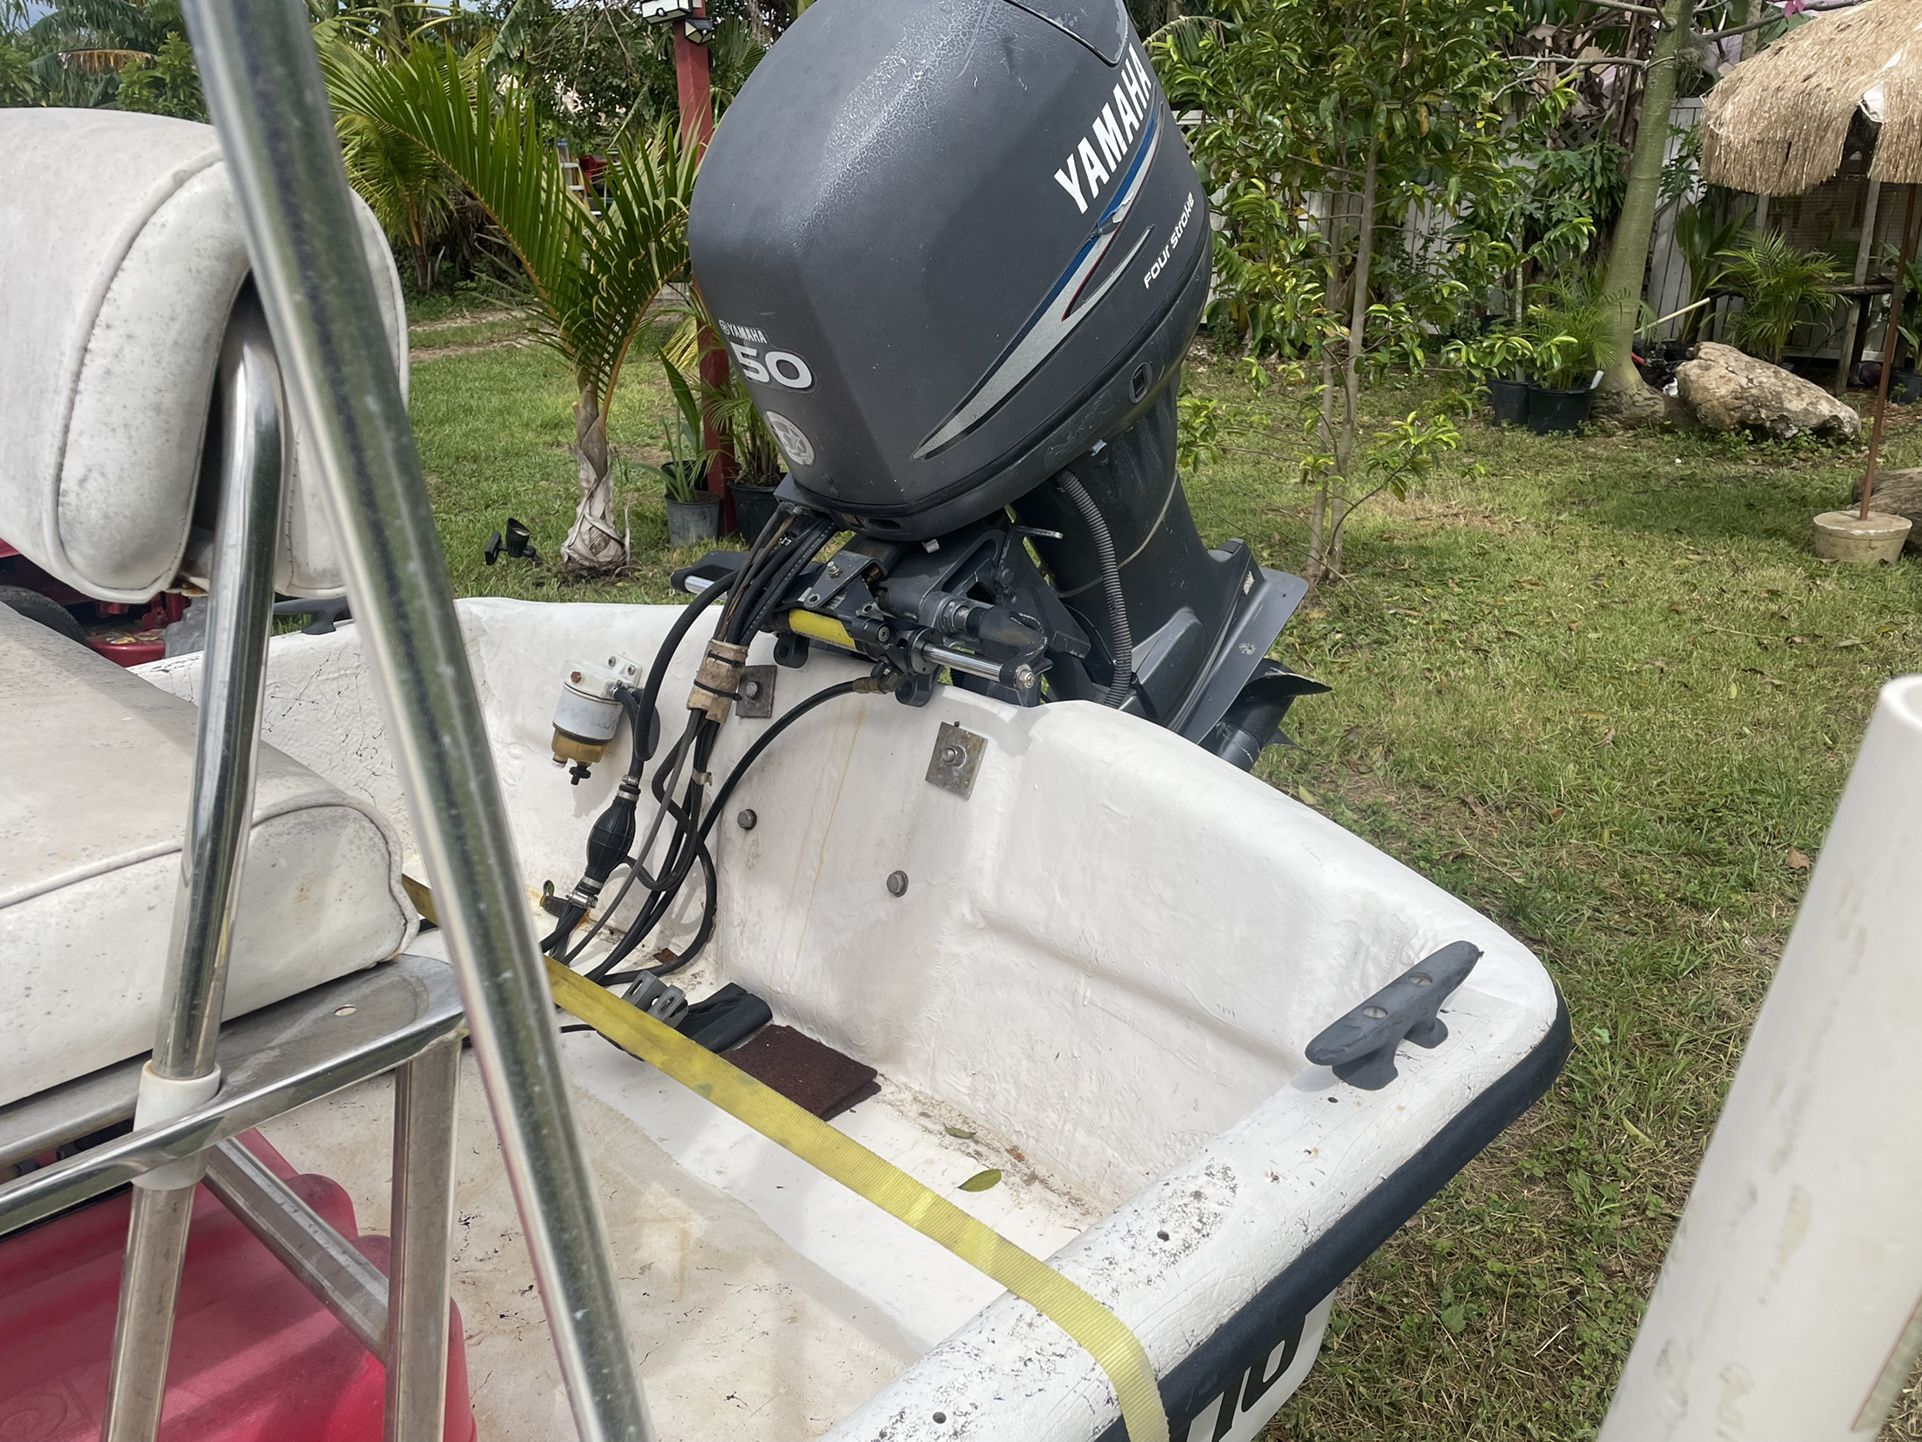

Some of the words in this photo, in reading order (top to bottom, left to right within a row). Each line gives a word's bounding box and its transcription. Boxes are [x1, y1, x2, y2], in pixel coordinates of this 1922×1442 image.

[1054, 43, 1152, 214] YAMAHA
[728, 323, 767, 343] YAMAHA
[730, 341, 812, 388] 50
